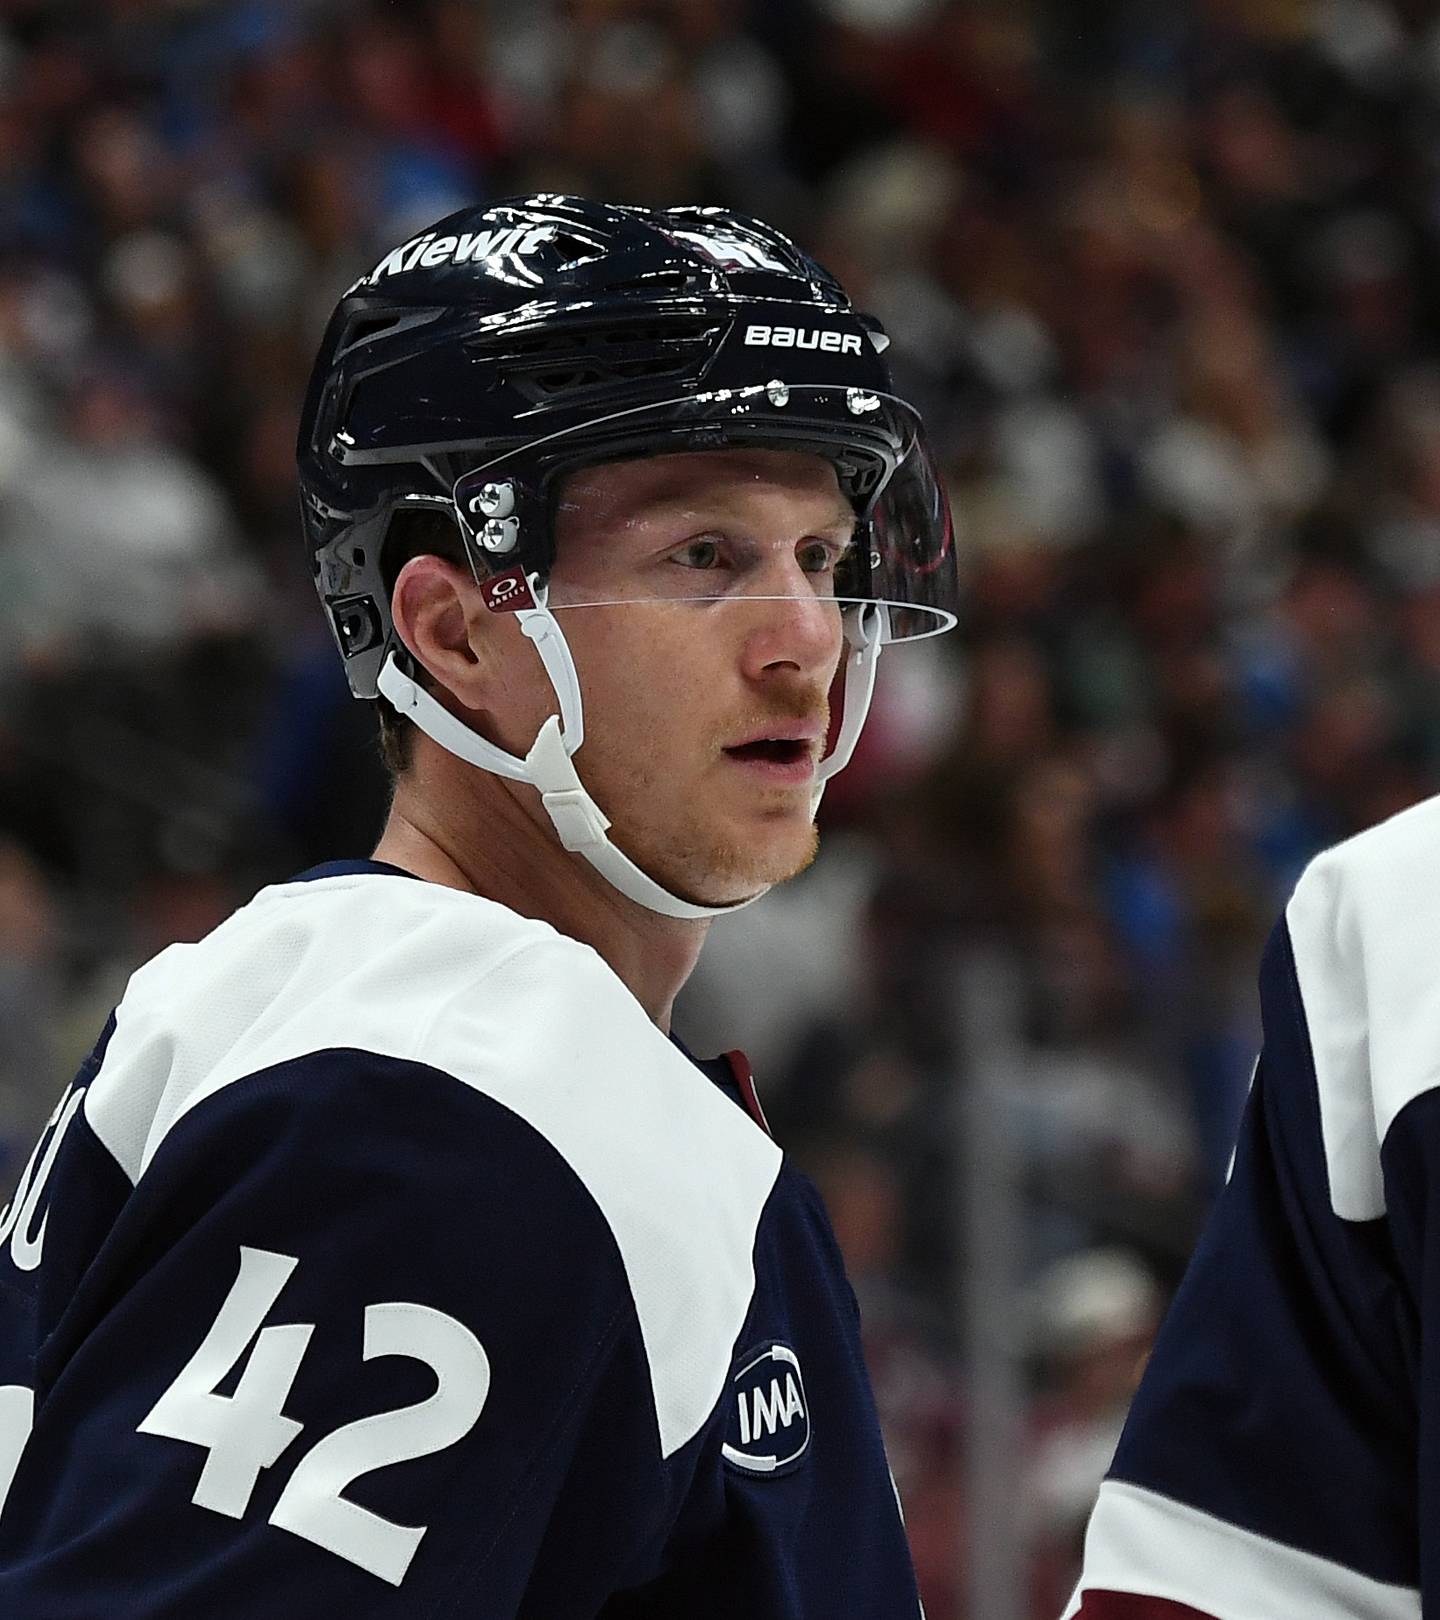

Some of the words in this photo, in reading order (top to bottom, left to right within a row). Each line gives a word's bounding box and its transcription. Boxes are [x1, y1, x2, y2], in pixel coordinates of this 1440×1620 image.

[369, 222, 558, 286] Kiewit
[744, 325, 862, 356] BAUER
[488, 585, 526, 608] OAKLEY
[135, 1245, 491, 1587] 42
[737, 1372, 805, 1445] IMA
